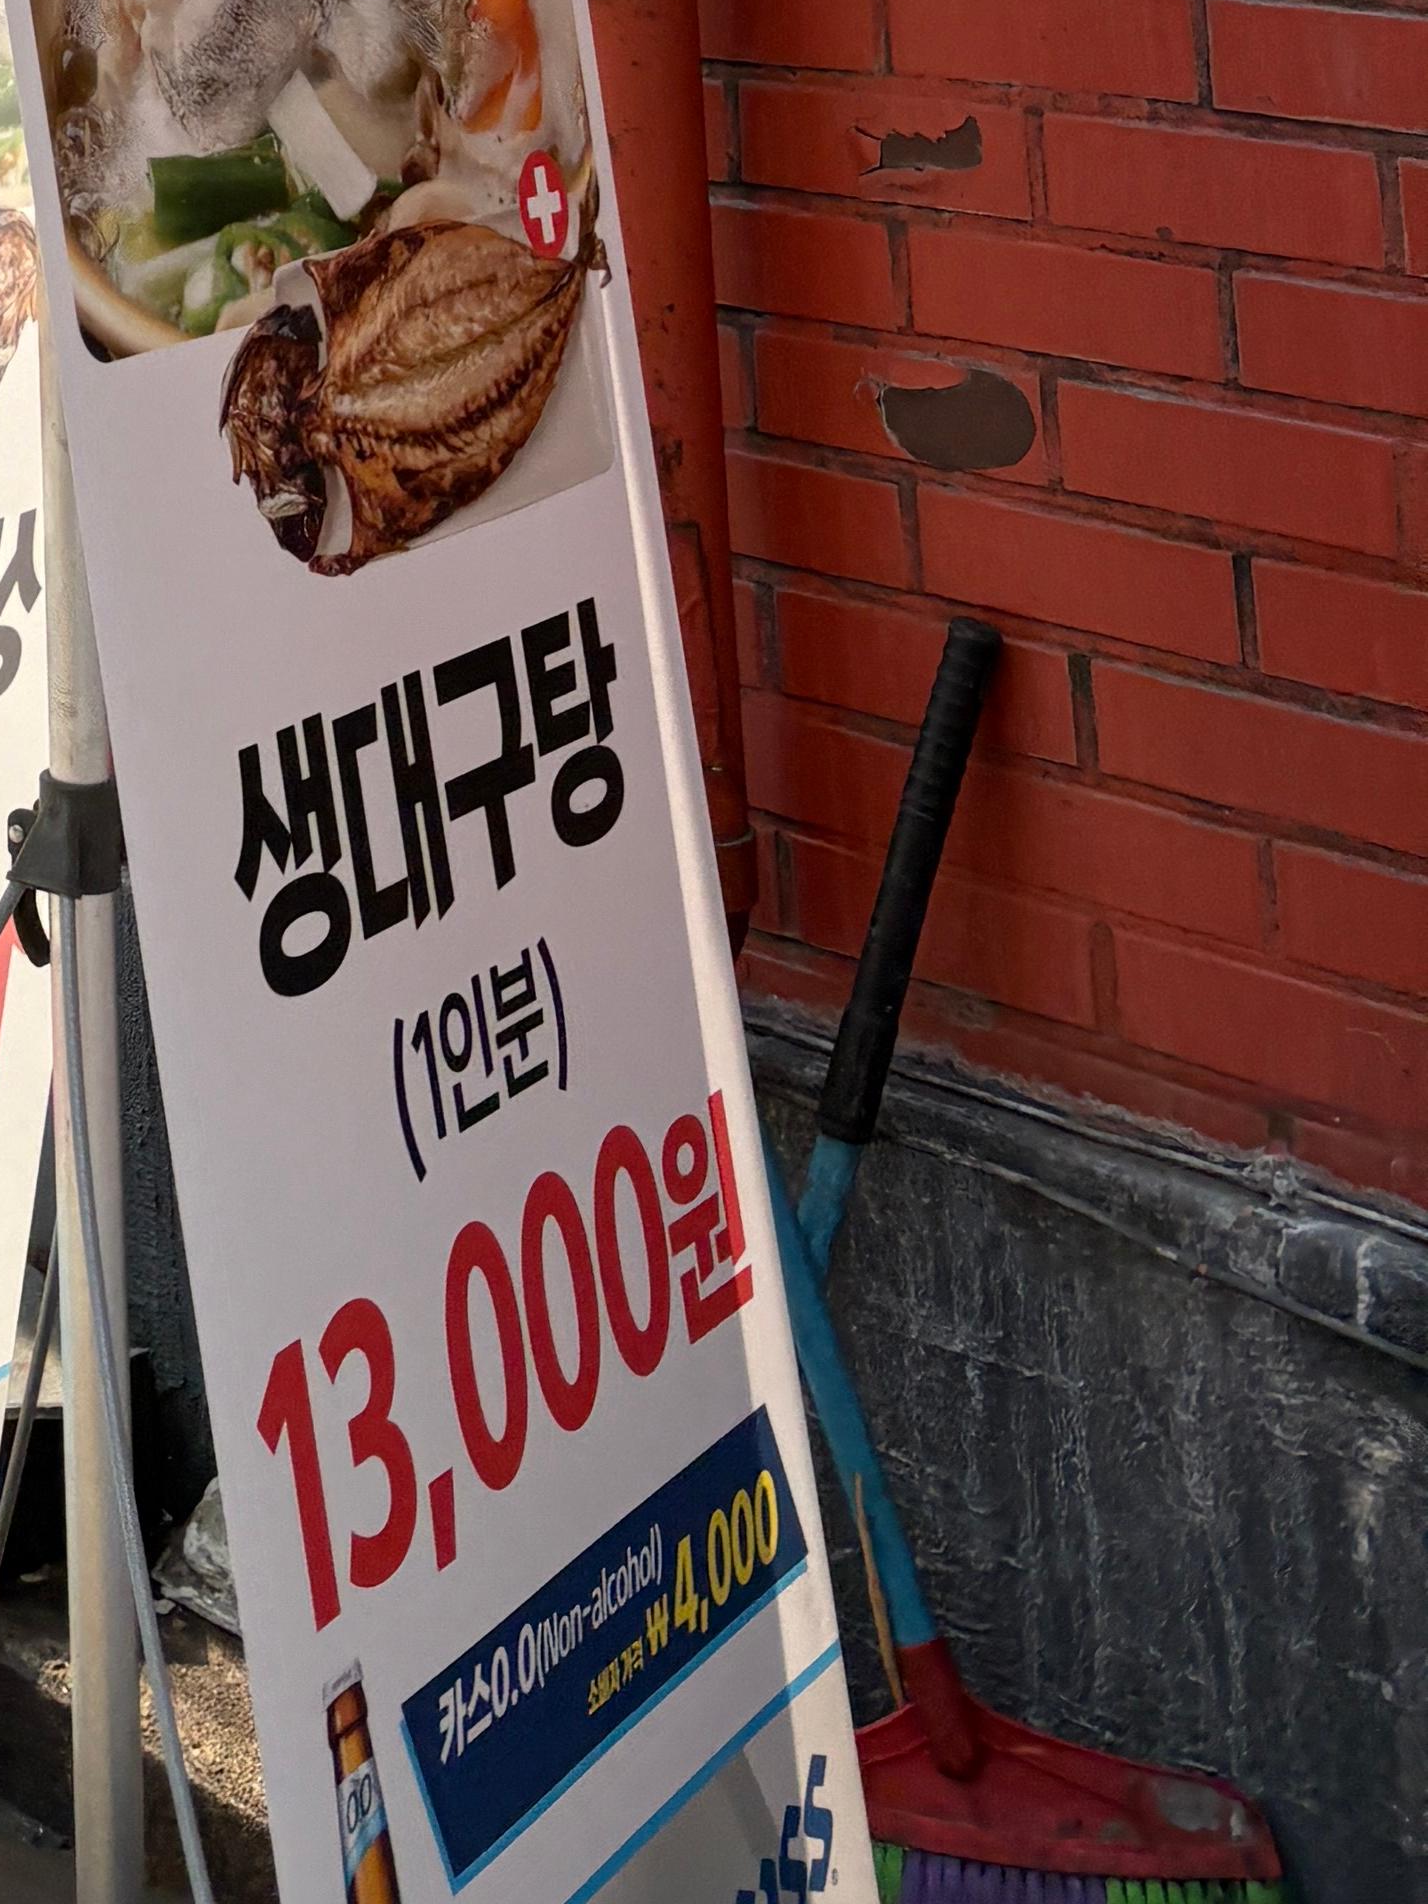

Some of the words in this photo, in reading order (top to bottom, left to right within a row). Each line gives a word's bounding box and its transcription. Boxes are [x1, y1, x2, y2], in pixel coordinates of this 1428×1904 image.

[233, 597, 626, 999] 생대구탕
[392, 937, 568, 1183] (1인분)
[256, 1088, 754, 1633] 13,000원
